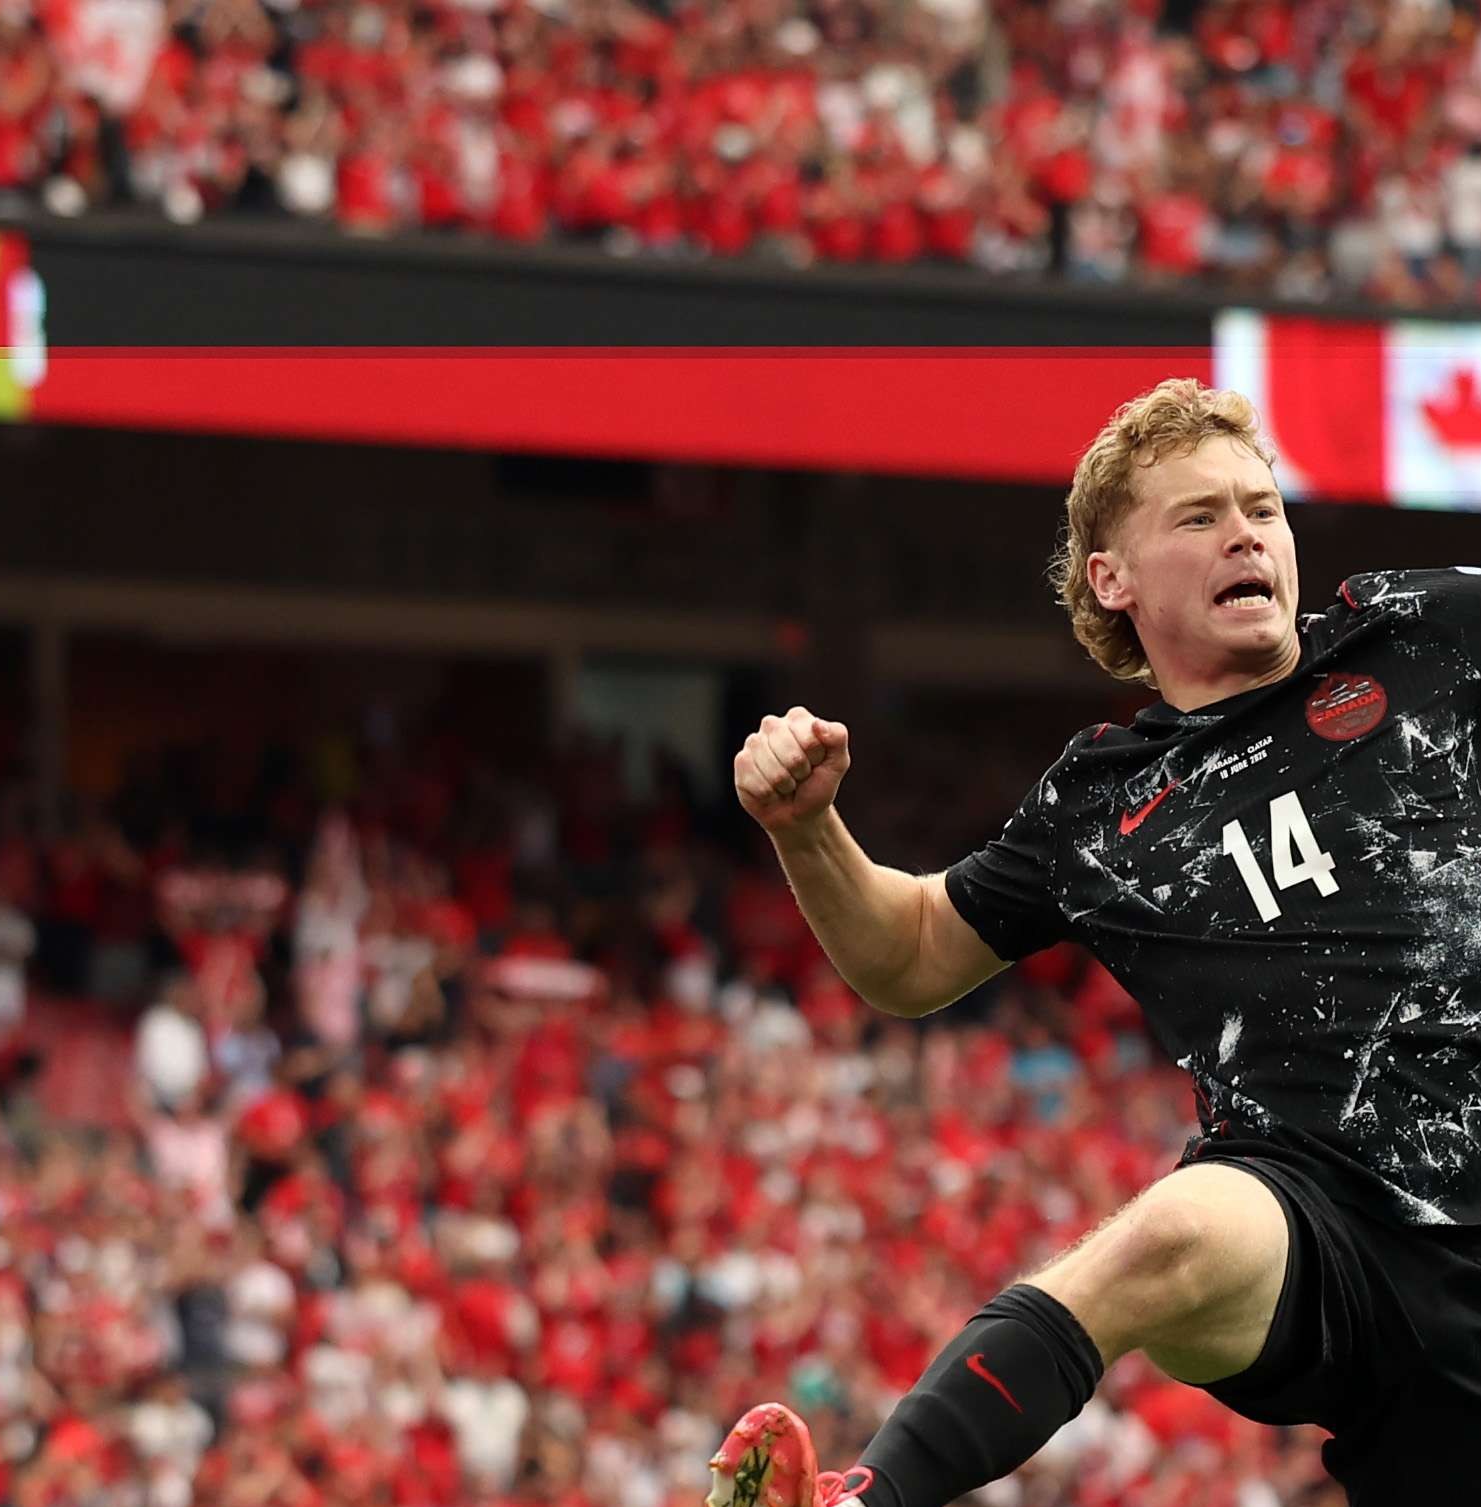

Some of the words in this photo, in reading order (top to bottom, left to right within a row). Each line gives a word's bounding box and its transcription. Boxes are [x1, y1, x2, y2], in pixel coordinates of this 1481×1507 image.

[1313, 691, 1381, 725] CANADA
[1247, 735, 1274, 754] QATAR
[1230, 759, 1249, 775] JUNE
[1249, 749, 1268, 764] 2026
[1222, 790, 1341, 924] 14
